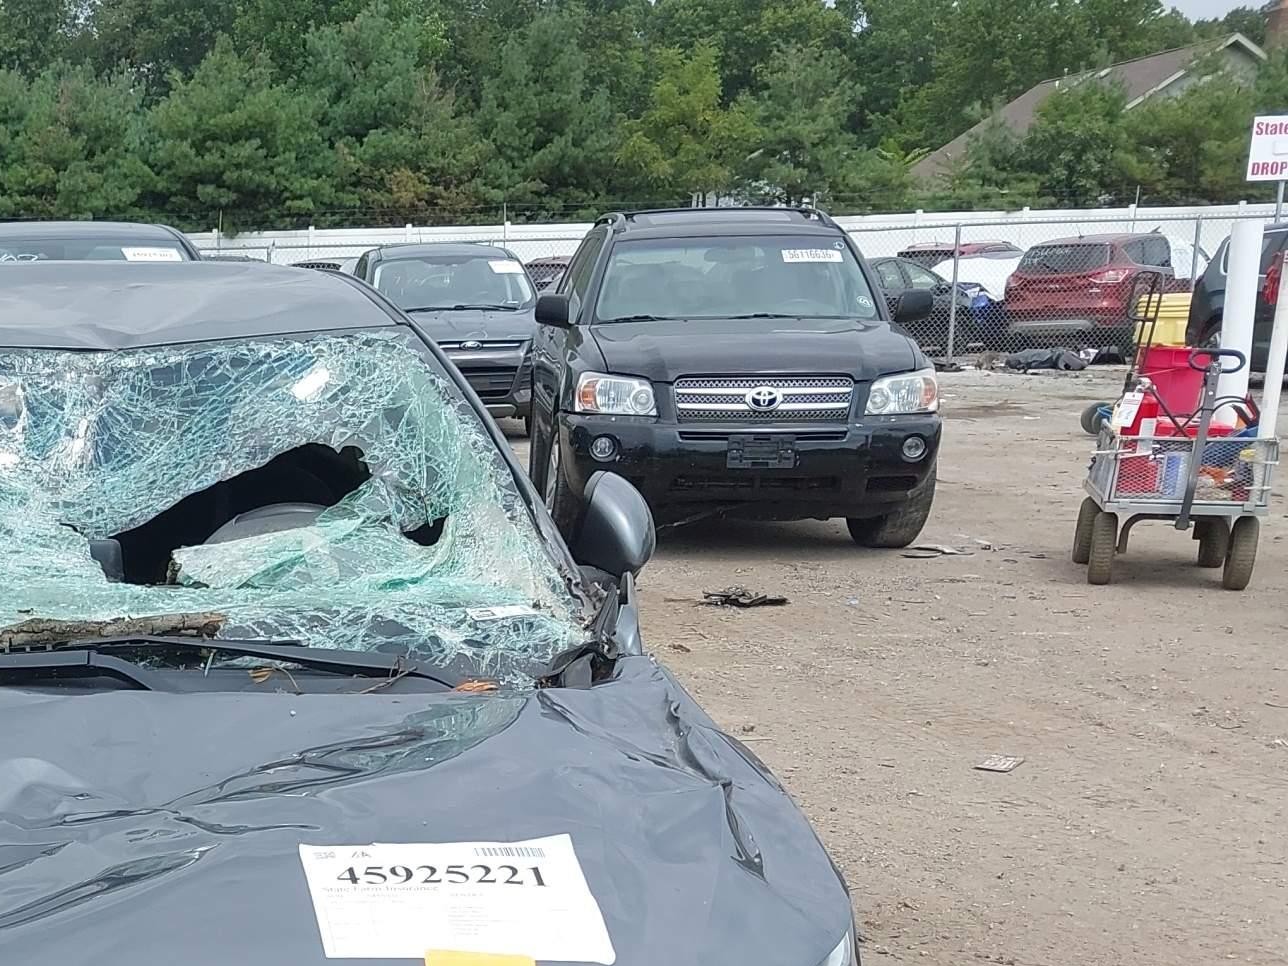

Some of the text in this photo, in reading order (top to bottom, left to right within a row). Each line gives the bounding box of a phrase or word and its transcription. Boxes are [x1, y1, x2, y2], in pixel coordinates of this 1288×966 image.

[1255, 121, 1288, 136] State
[1251, 161, 1288, 176] DROP
[337, 865, 547, 887] 45925221
